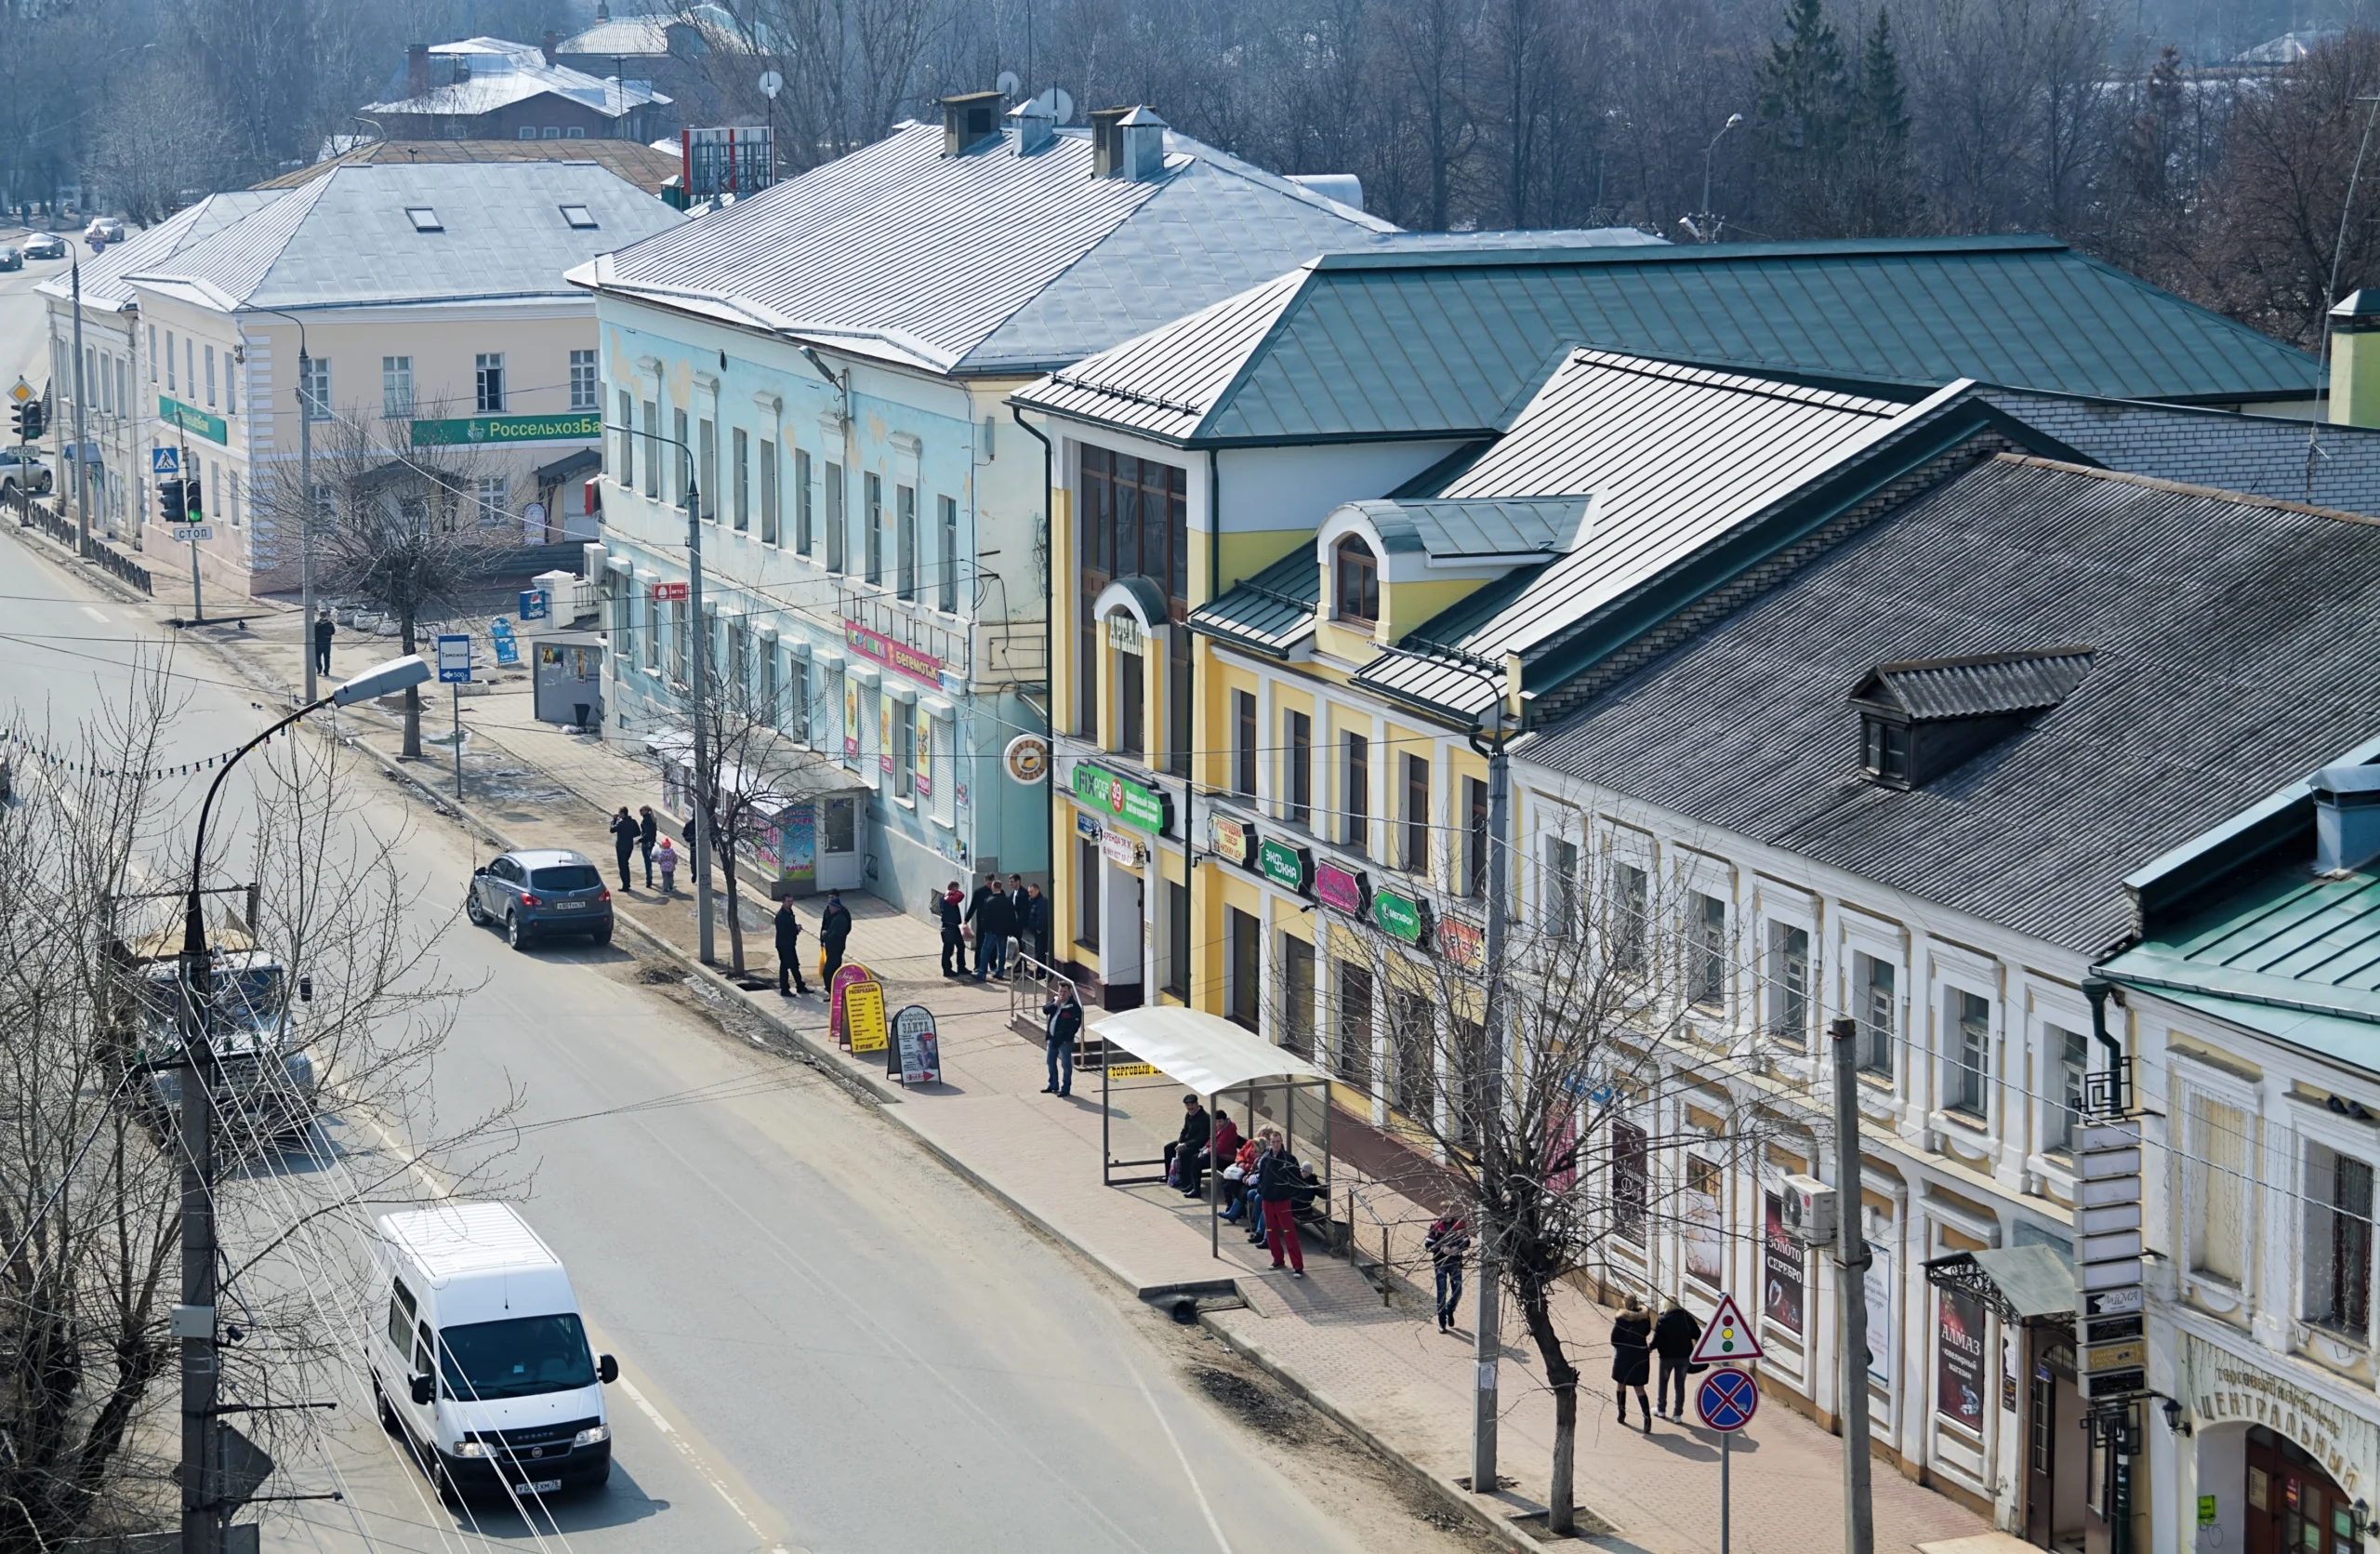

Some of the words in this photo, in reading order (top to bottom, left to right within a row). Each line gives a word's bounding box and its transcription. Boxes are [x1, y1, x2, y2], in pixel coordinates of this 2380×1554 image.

[12, 447, 35, 456] СТОП
[178, 528, 207, 538] СТОП
[1112, 781, 1123, 802] 39
[1112, 1065, 1150, 1076] ТОРГОВЫЙ
[1768, 1237, 1802, 1263] ЗОЛОТО
[1767, 1255, 1802, 1283] СЕРЕБРО
[1941, 1323, 1980, 1356] АЛМАЗ
[1943, 1348, 1977, 1370] ювелирный
[1948, 1362, 1972, 1379] магазин
